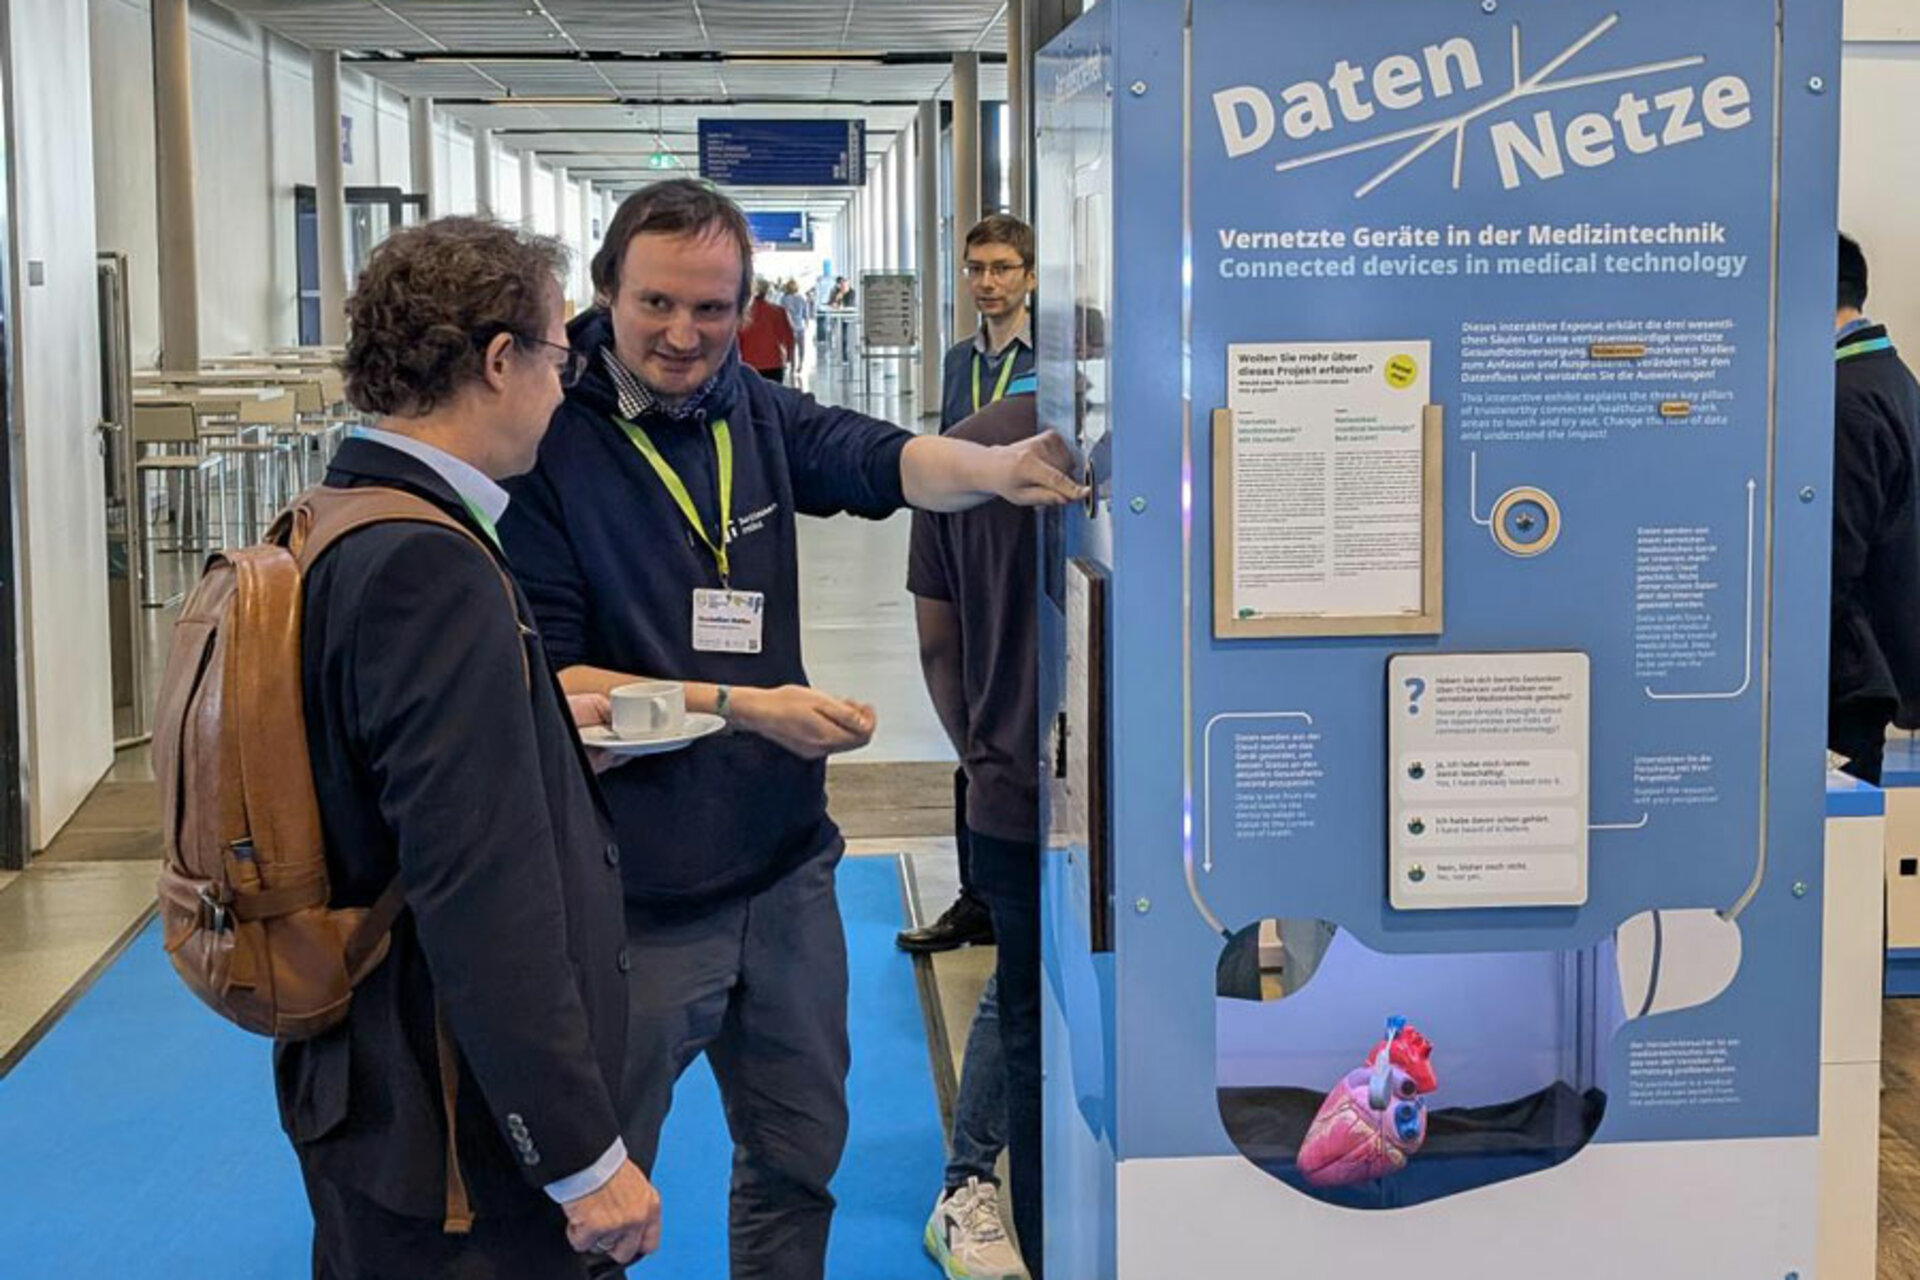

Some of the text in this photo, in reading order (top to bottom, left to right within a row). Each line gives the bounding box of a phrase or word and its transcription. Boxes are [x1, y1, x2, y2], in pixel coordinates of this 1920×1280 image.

[1213, 35, 1483, 158] Daten
[1491, 74, 1752, 190] Netze
[1219, 224, 1726, 250] Vernetzte Geräte in der Medizintechnik
[1219, 253, 1748, 280] Connected devices in medical technology
[1462, 321, 1497, 332] Dieses
[1499, 321, 1558, 331] interaktive
[1560, 320, 1604, 333] Exponat
[1606, 320, 1643, 330] erklärt
[1645, 319, 1662, 330] die
[1664, 319, 1686, 329] drei
[1462, 334, 1488, 344] chen
[1490, 334, 1526, 344] Säulen
[1527, 334, 1544, 344] für
[1546, 333, 1569, 344] eine
[1673, 332, 1723, 342] vernetzte
[1238, 352, 1358, 363] Wollen Sie mehr über
[1461, 361, 1485, 369] zum
[1486, 358, 1535, 369] Anfassen
[1537, 358, 1558, 368] und
[1692, 356, 1709, 367] Sie
[1710, 356, 1730, 366] den
[1238, 365, 1373, 378] dieses Projekt erfahren?
[1461, 372, 1519, 382] Datenfluss
[1520, 371, 1542, 382] und
[1544, 370, 1598, 381] verstehen
[1599, 370, 1615, 380] Sie
[1617, 370, 1634, 380] die
[1462, 392, 1483, 402] This
[1485, 391, 1543, 402] interactive
[1544, 390, 1581, 401] exhibit
[1583, 390, 1628, 403] explains
[1629, 390, 1647, 400] the
[1461, 404, 1472, 415] of
[1540, 403, 1596, 414] connected
[1461, 419, 1490, 428] areas
[1492, 417, 1504, 427] to
[1506, 417, 1537, 427] touch
[1539, 416, 1560, 427] and
[1562, 416, 1577, 429] try
[1602, 416, 1643, 429] Change
[1461, 430, 1481, 440] and
[1483, 429, 1545, 440] understand
[1547, 429, 1565, 439] the
